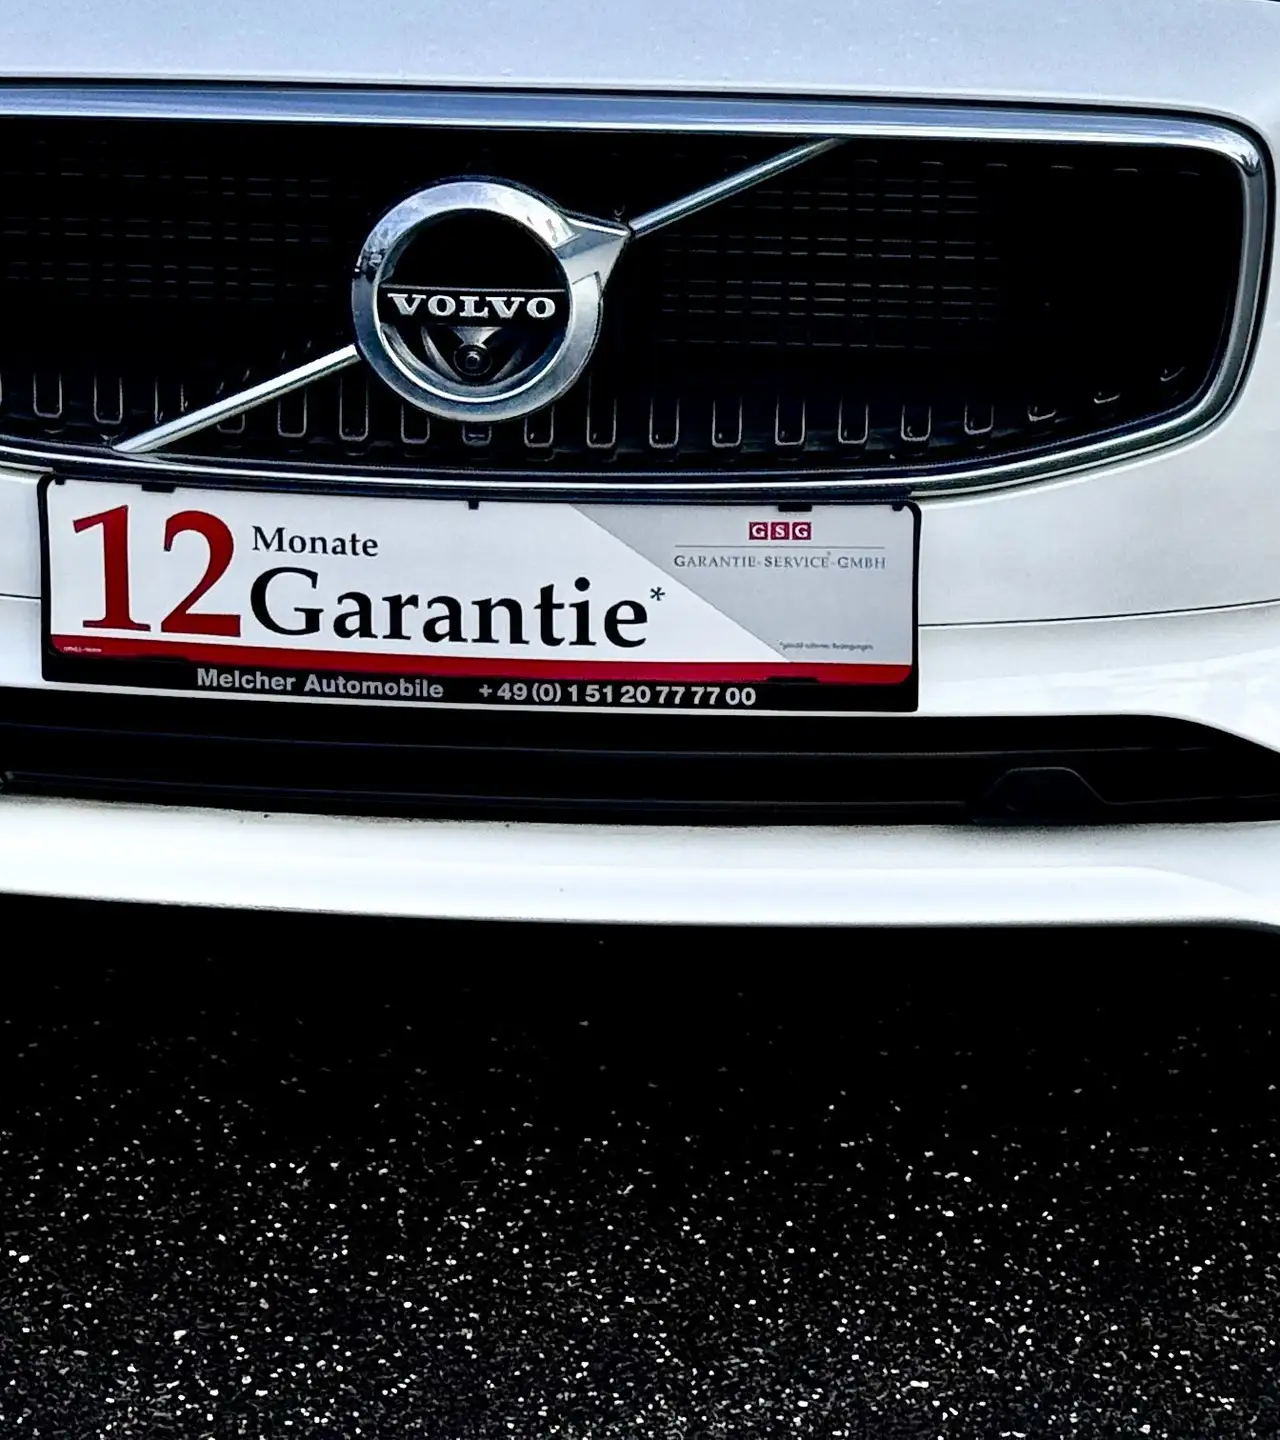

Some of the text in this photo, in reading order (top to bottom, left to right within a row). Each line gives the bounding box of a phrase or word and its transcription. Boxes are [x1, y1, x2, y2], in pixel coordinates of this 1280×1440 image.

[387, 293, 556, 319] VOLVO
[252, 526, 379, 557] Monate
[750, 523, 810, 539] GSG
[73, 504, 241, 637] 12
[197, 668, 296, 691] Melcher
[304, 674, 444, 698] Automobile
